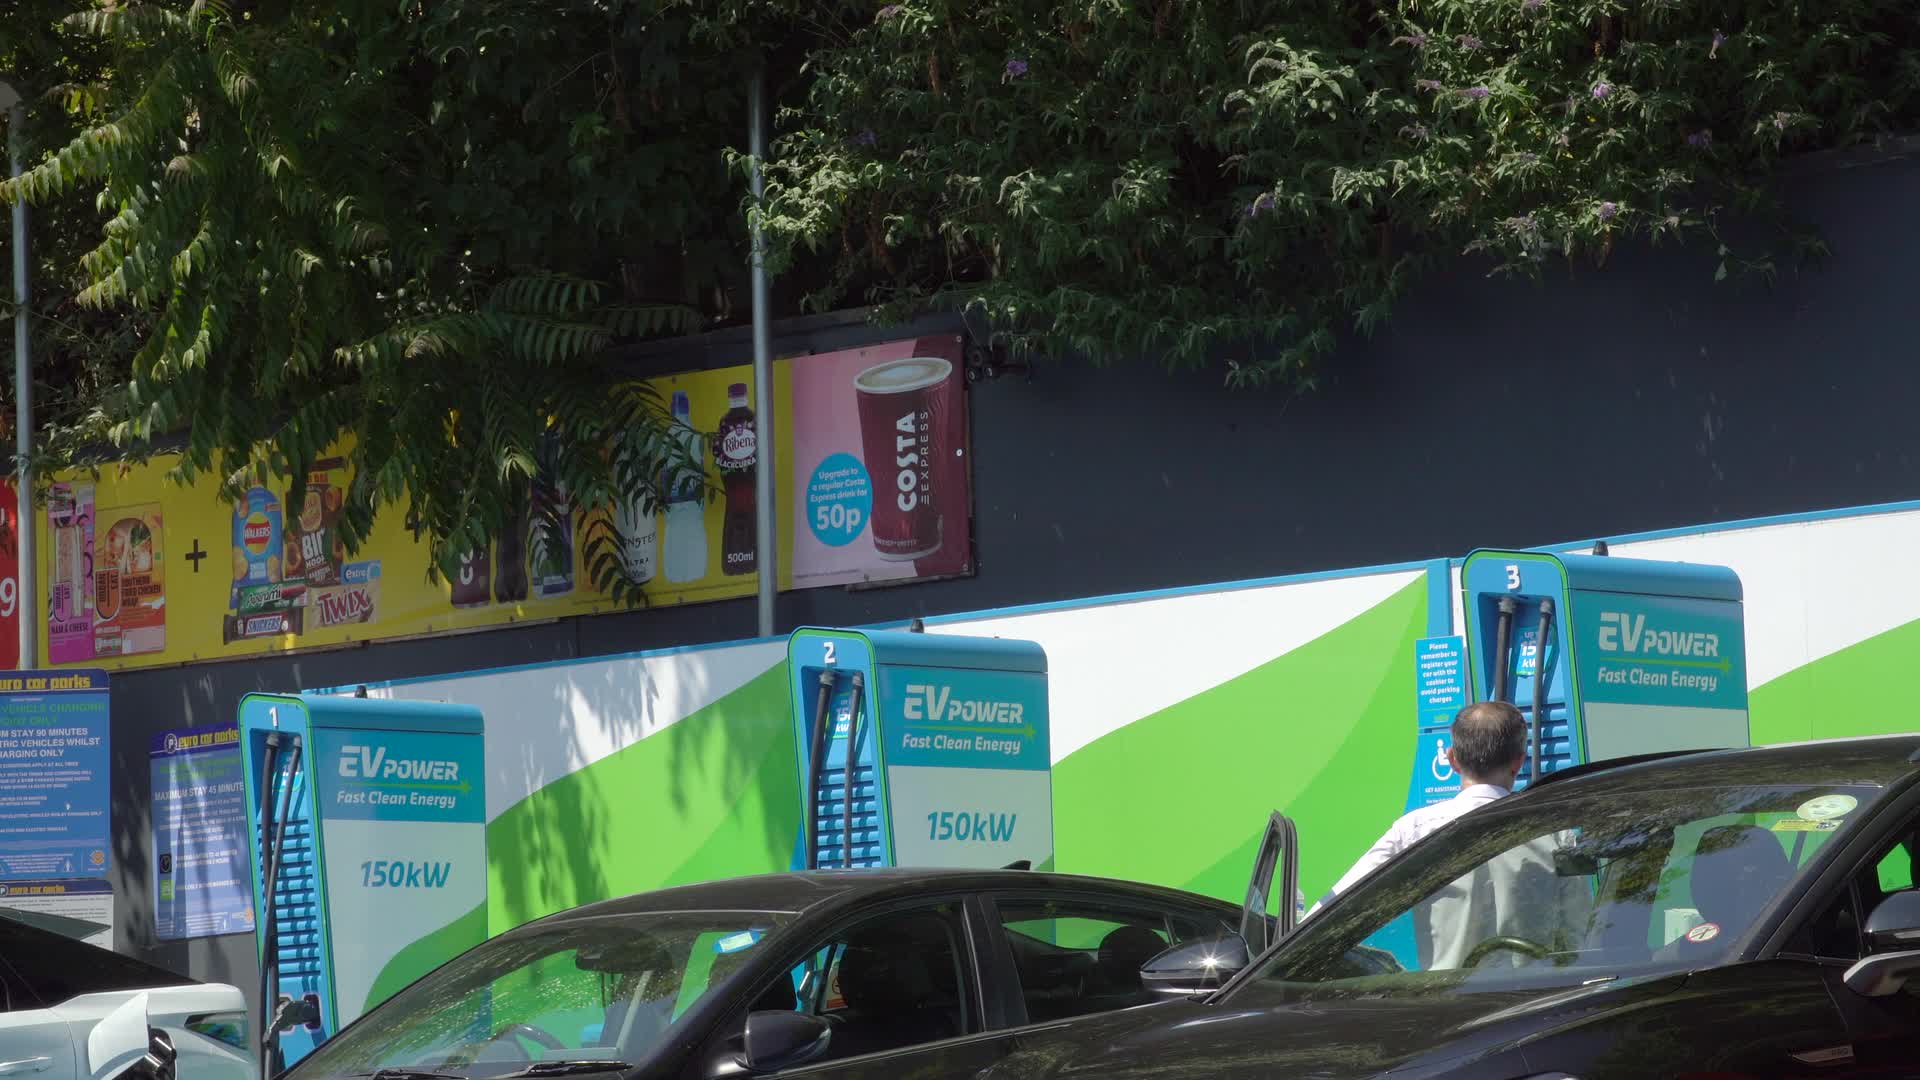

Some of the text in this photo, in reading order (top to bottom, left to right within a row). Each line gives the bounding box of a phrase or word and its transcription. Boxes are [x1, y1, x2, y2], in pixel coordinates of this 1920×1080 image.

[724, 436, 756, 452] Ribena
[920, 411, 930, 492] EXPRESS
[896, 412, 919, 512] COSTA
[818, 467, 859, 481] Upgrade to
[845, 477, 865, 487] Costa
[810, 489, 868, 503] Express drink for
[816, 503, 861, 534] 50p
[244, 525, 272, 539] WALKERS
[727, 551, 755, 564] 500ml
[1505, 564, 1521, 590] 3
[247, 616, 282, 634] SNICKERS
[823, 641, 835, 664] 2
[1421, 652, 1451, 660] remember
[1421, 659, 1458, 669] register your
[0, 674, 91, 690] uro car parks
[1598, 666, 1718, 692] Fast Clean Energy
[1420, 686, 1460, 696] avoid parking
[1429, 696, 1453, 704] charges
[269, 706, 279, 727] 1
[11, 729, 34, 737] STAY
[36, 729, 47, 737] 90
[48, 727, 88, 736] MINUTES
[21, 738, 65, 747] VEHICLES
[66, 737, 101, 746] WHILST
[902, 733, 1021, 755] Fast Clean Energy
[40, 749, 64, 757] ONLY
[189, 786, 208, 796] STAY
[209, 784, 217, 793] 45
[218, 781, 245, 792] MINUTE
[336, 790, 456, 808] Fast Clean Energy
[927, 812, 1017, 842] 150kW
[360, 860, 451, 888] 150kW
